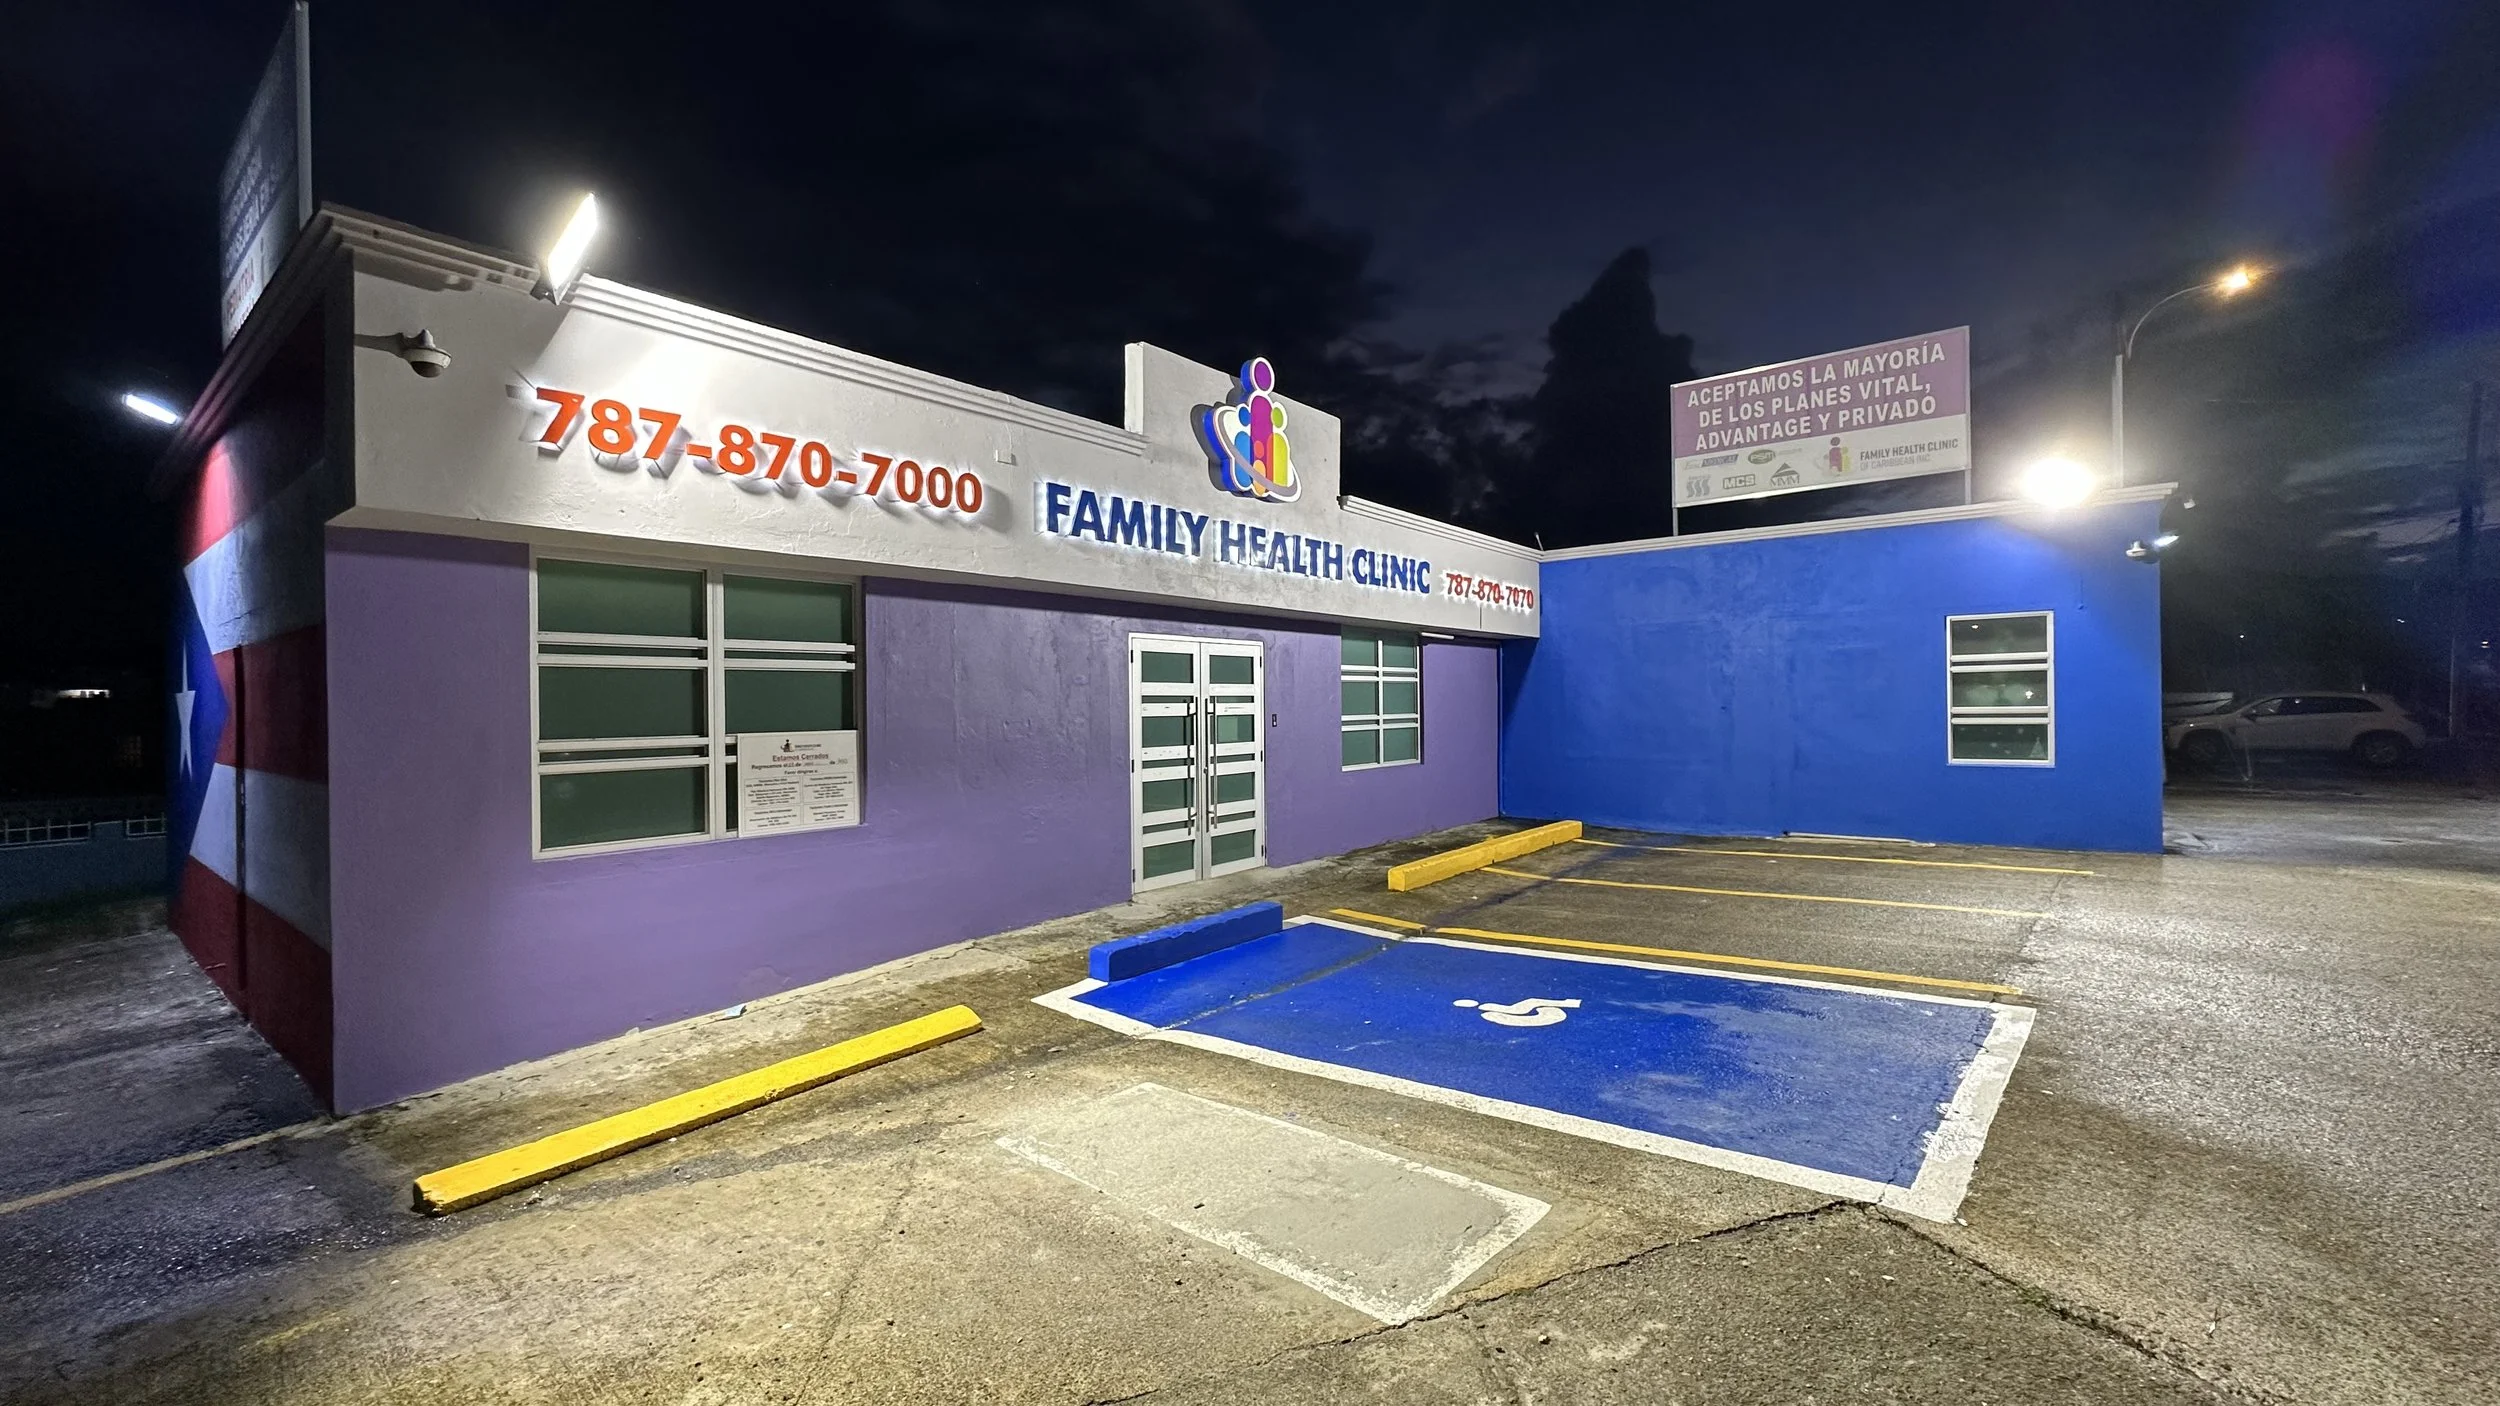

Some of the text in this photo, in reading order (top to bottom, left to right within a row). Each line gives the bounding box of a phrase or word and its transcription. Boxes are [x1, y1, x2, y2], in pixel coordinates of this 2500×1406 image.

[1688, 341, 1945, 408] ACEPTAMOS LA MAYORÍA
[1699, 373, 1931, 428] DE LOS PLANES VITAL,
[536, 386, 983, 514] 787-870-7000
[1696, 395, 1936, 451] ADVANTAGE Y PRIVADO
[1860, 438, 1959, 461] FAMILY HEALTH CLINIC
[1723, 475, 1756, 489] MCS
[1770, 474, 1801, 487] MMM
[1046, 481, 1431, 594] FAMILY HEALTH CLINIC
[1446, 572, 1534, 610] 787-870-7070
